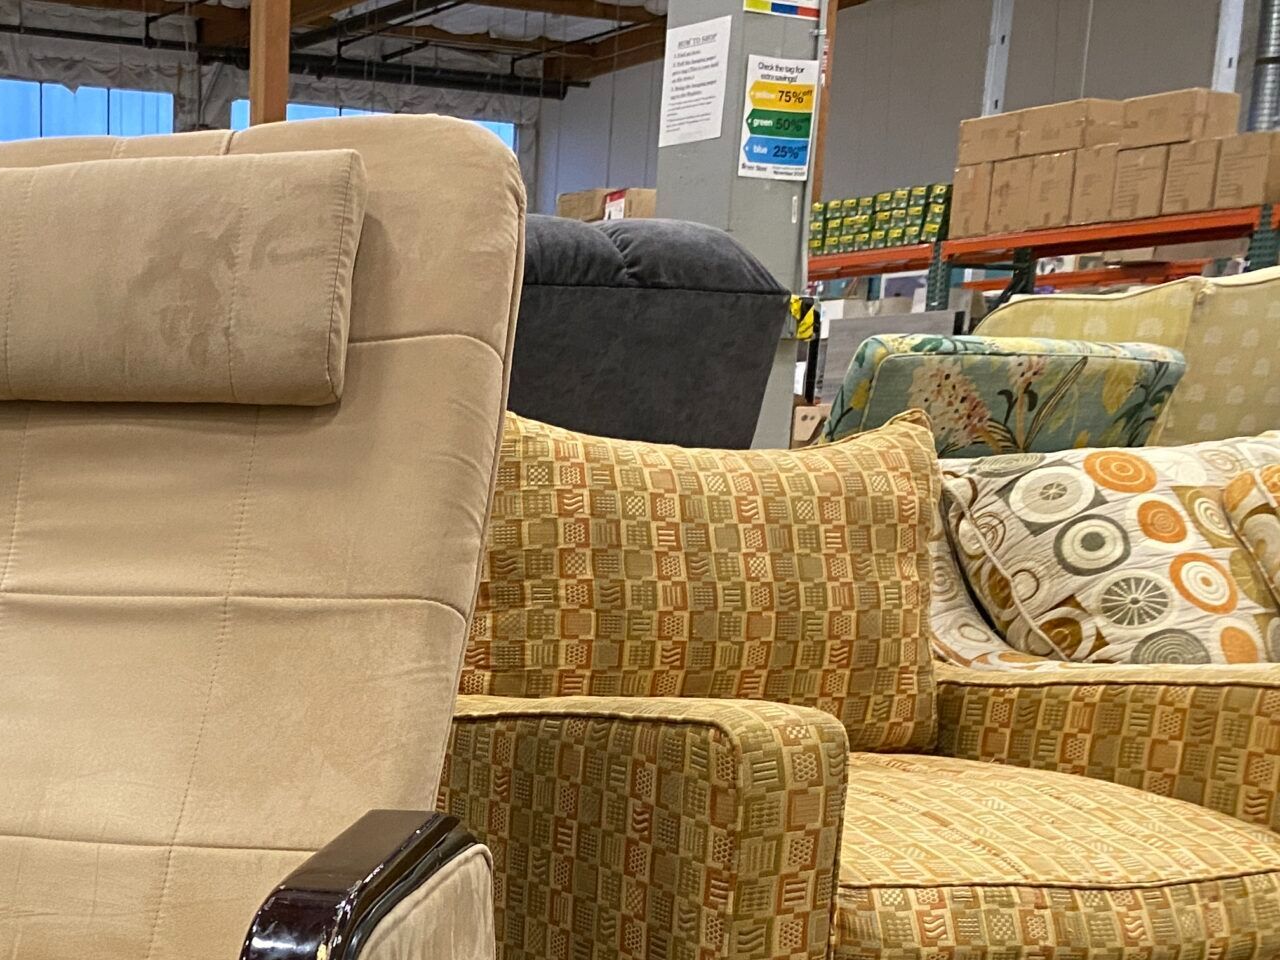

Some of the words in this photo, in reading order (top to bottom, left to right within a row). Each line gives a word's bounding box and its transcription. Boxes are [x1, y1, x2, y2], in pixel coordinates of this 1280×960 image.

[758, 62, 774, 71] Check
[775, 64, 784, 72] the
[785, 66, 795, 74] tag
[778, 90, 804, 103] 75%
[753, 118, 773, 127] green
[776, 118, 802, 131] 50%
[753, 144, 768, 154] blue
[773, 145, 799, 159] 25%
